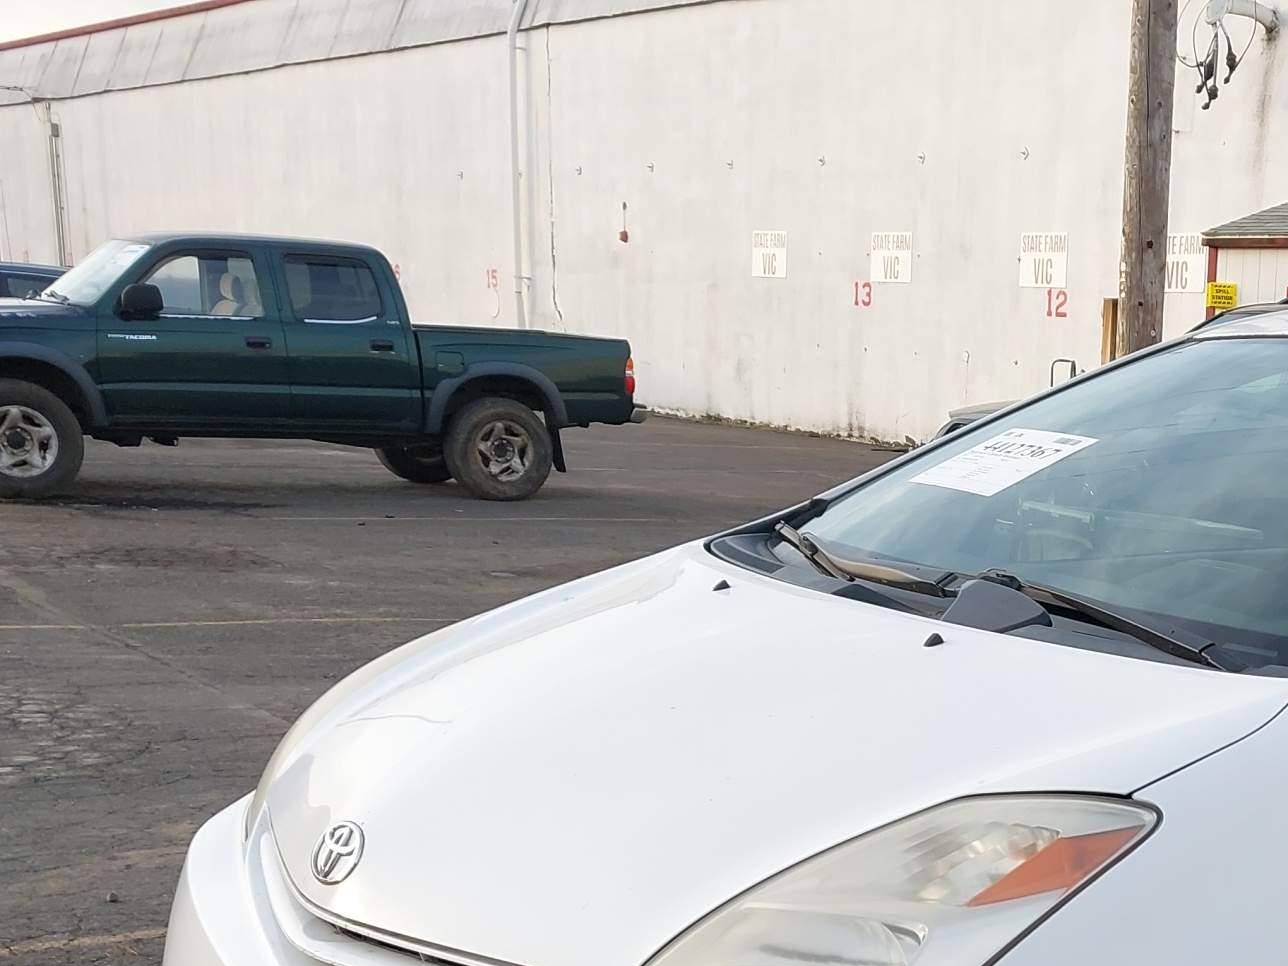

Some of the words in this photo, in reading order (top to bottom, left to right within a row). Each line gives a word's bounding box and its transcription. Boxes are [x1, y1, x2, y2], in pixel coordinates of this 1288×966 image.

[754, 233, 769, 248] STATE
[770, 233, 786, 249] FARM
[872, 234, 891, 251] STATE
[892, 235, 911, 251] FARM
[1022, 235, 1043, 253] STATE
[1044, 235, 1067, 253] FARM
[762, 253, 777, 276] VIC
[883, 255, 900, 280] VIC
[1034, 258, 1053, 285] VIC
[1166, 260, 1188, 290] VIC
[486, 269, 498, 289] 15
[854, 281, 873, 306] 13
[1047, 288, 1068, 318] 12
